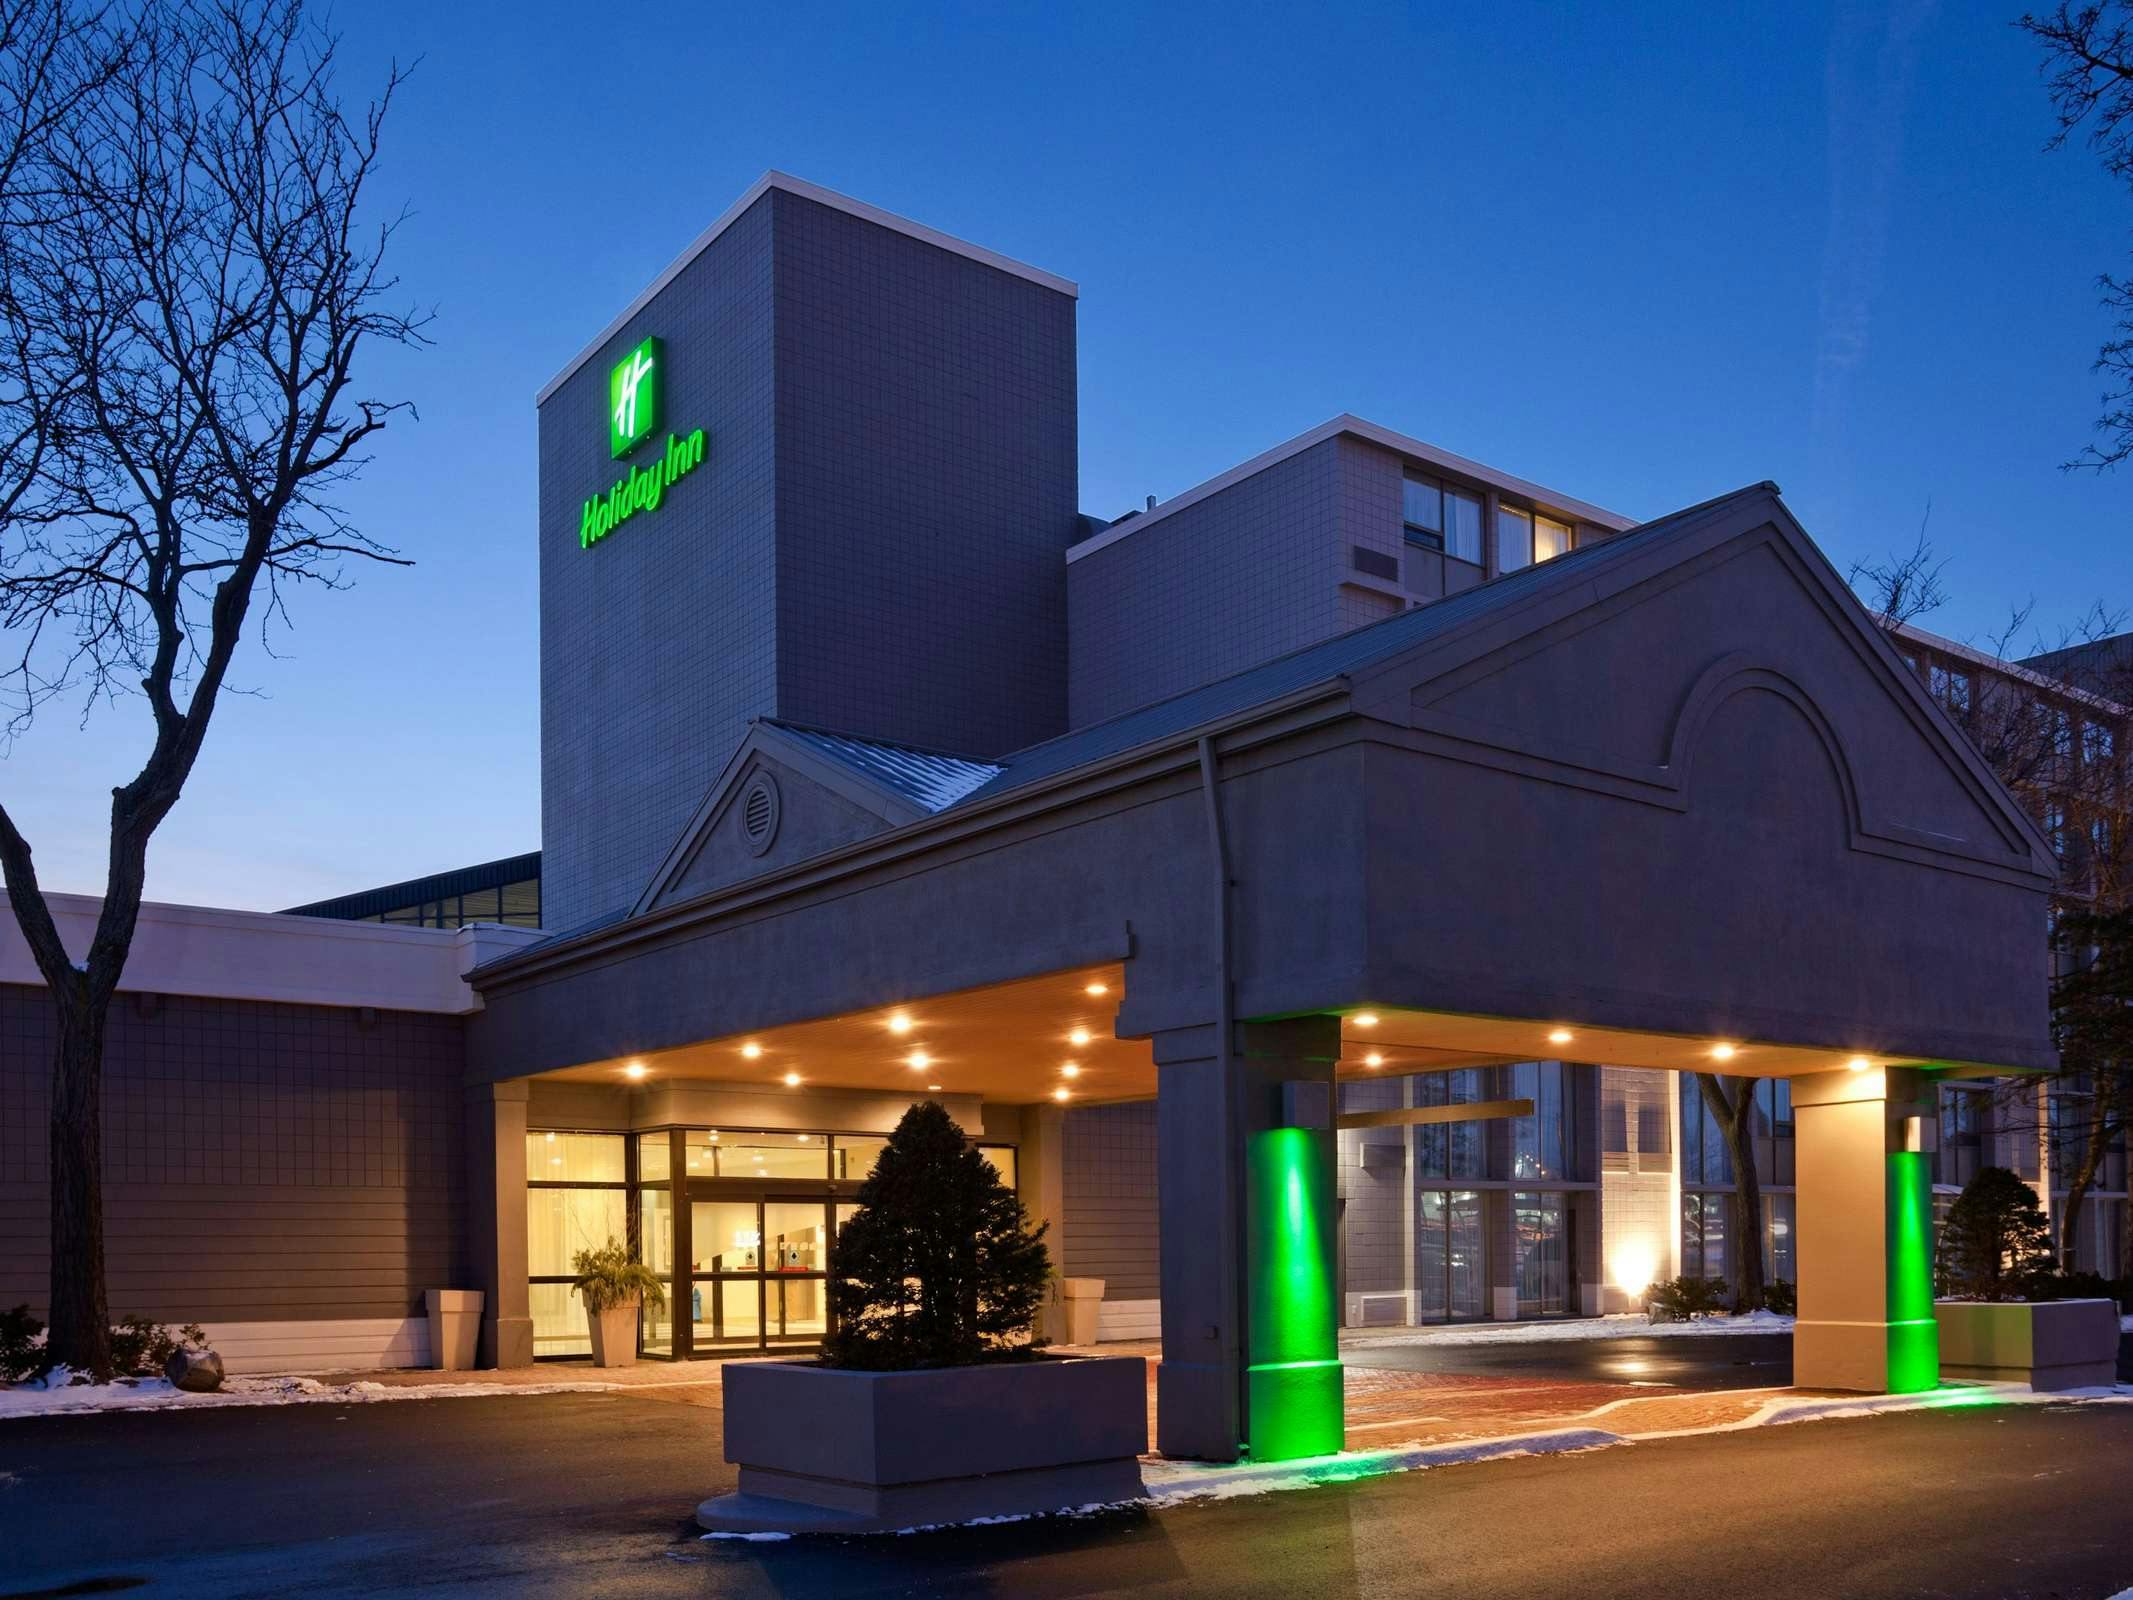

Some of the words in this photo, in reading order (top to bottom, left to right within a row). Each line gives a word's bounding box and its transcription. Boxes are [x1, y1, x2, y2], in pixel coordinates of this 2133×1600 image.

[615, 350, 654, 437] H
[580, 459, 664, 549] Holiday
[665, 428, 704, 486] Inn
